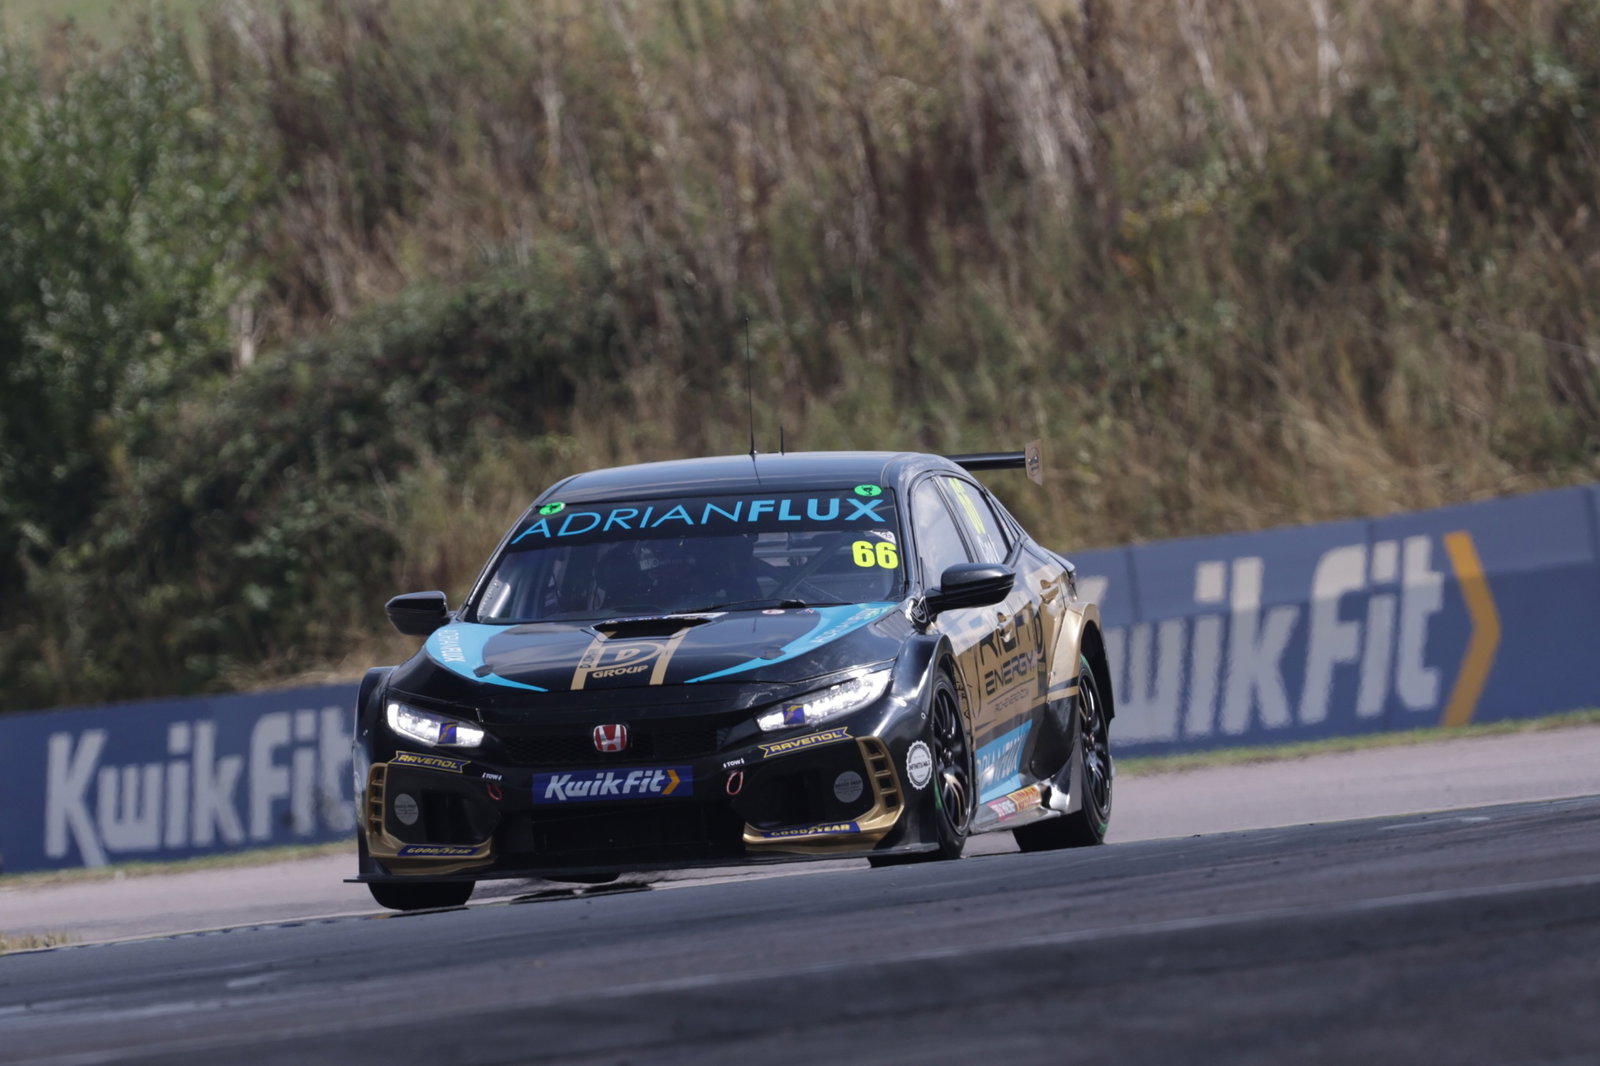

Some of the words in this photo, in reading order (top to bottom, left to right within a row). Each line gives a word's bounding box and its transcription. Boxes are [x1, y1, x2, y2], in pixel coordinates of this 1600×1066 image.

[511, 498, 885, 545] ADRIANFLUX
[852, 540, 899, 570] 66
[1077, 534, 1443, 746] wikFit
[592, 665, 648, 679] GROUP
[984, 651, 1034, 696] ENERGY
[770, 732, 842, 752] RAVENOL
[398, 754, 459, 769] RAVENOL
[771, 825, 850, 836] GOODYEAR
[407, 847, 472, 855] GOODYEAR
